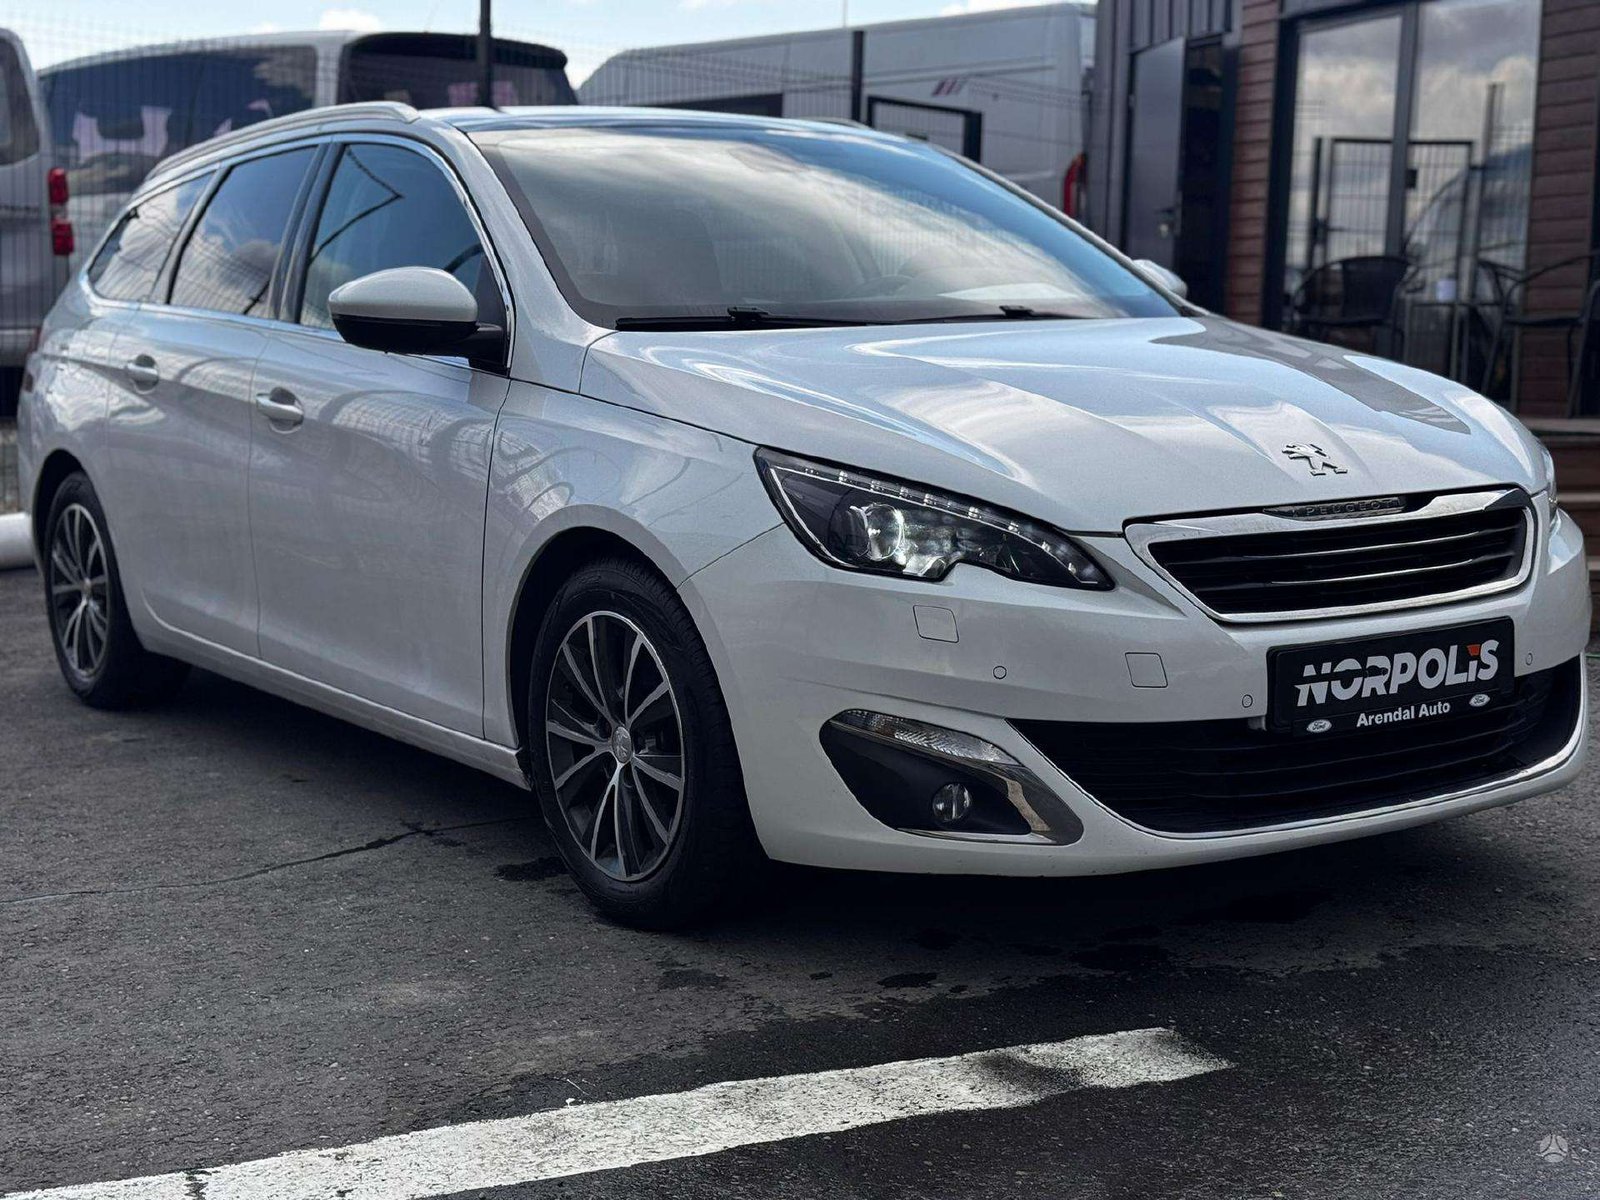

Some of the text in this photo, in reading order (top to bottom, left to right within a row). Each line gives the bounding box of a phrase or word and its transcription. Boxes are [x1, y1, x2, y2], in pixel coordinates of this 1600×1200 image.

[1305, 499, 1396, 515] PEUGEOT
[1356, 702, 1451, 727] Arendal Auto
